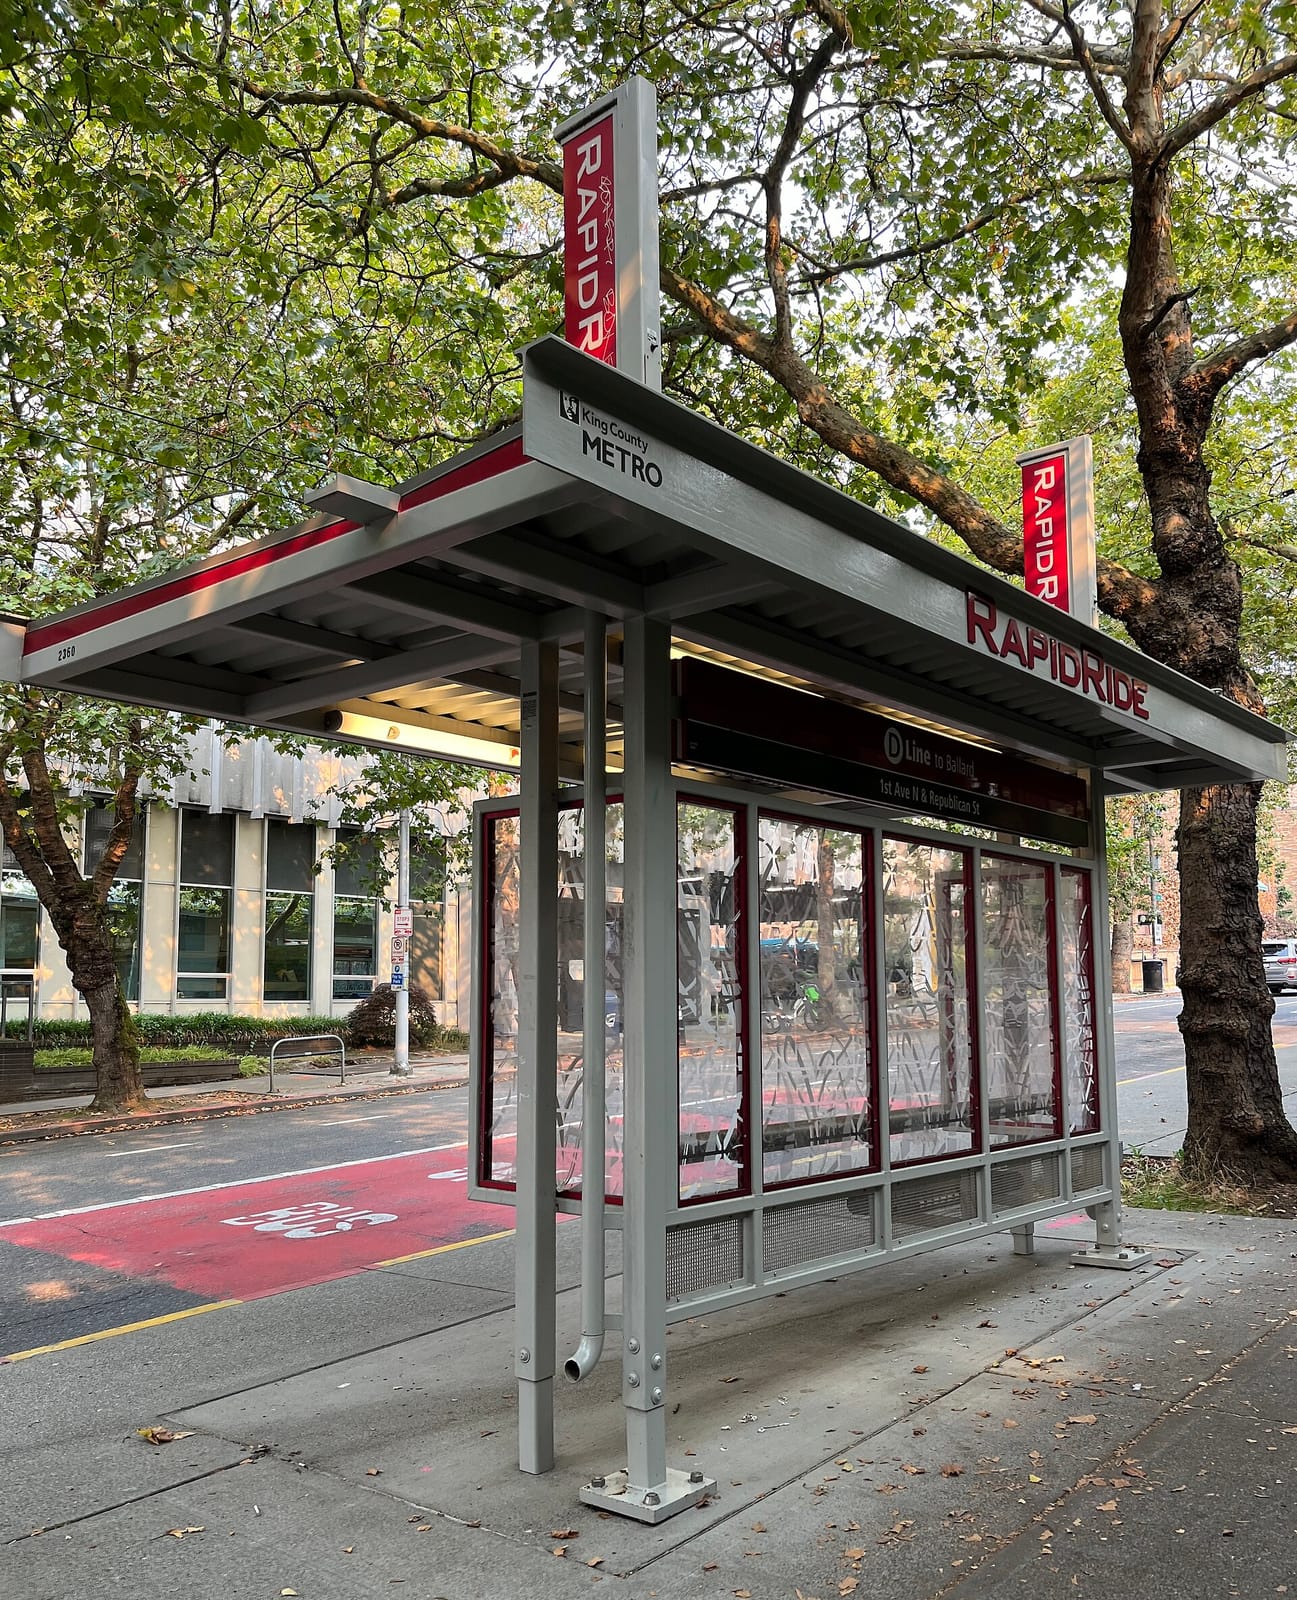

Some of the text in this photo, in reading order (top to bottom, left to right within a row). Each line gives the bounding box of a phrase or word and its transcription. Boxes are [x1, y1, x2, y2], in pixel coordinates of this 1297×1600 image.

[582, 408, 648, 454] King County
[583, 429, 663, 488] METRO
[1034, 465, 1059, 603] RAPIDR
[58, 645, 76, 661] 2360
[966, 588, 1149, 720] RAPIDRIDE
[905, 740, 931, 766] Line
[934, 753, 944, 769] to
[946, 754, 975, 777] Ballard
[880, 779, 980, 815] 1st Ave N & Republican St
